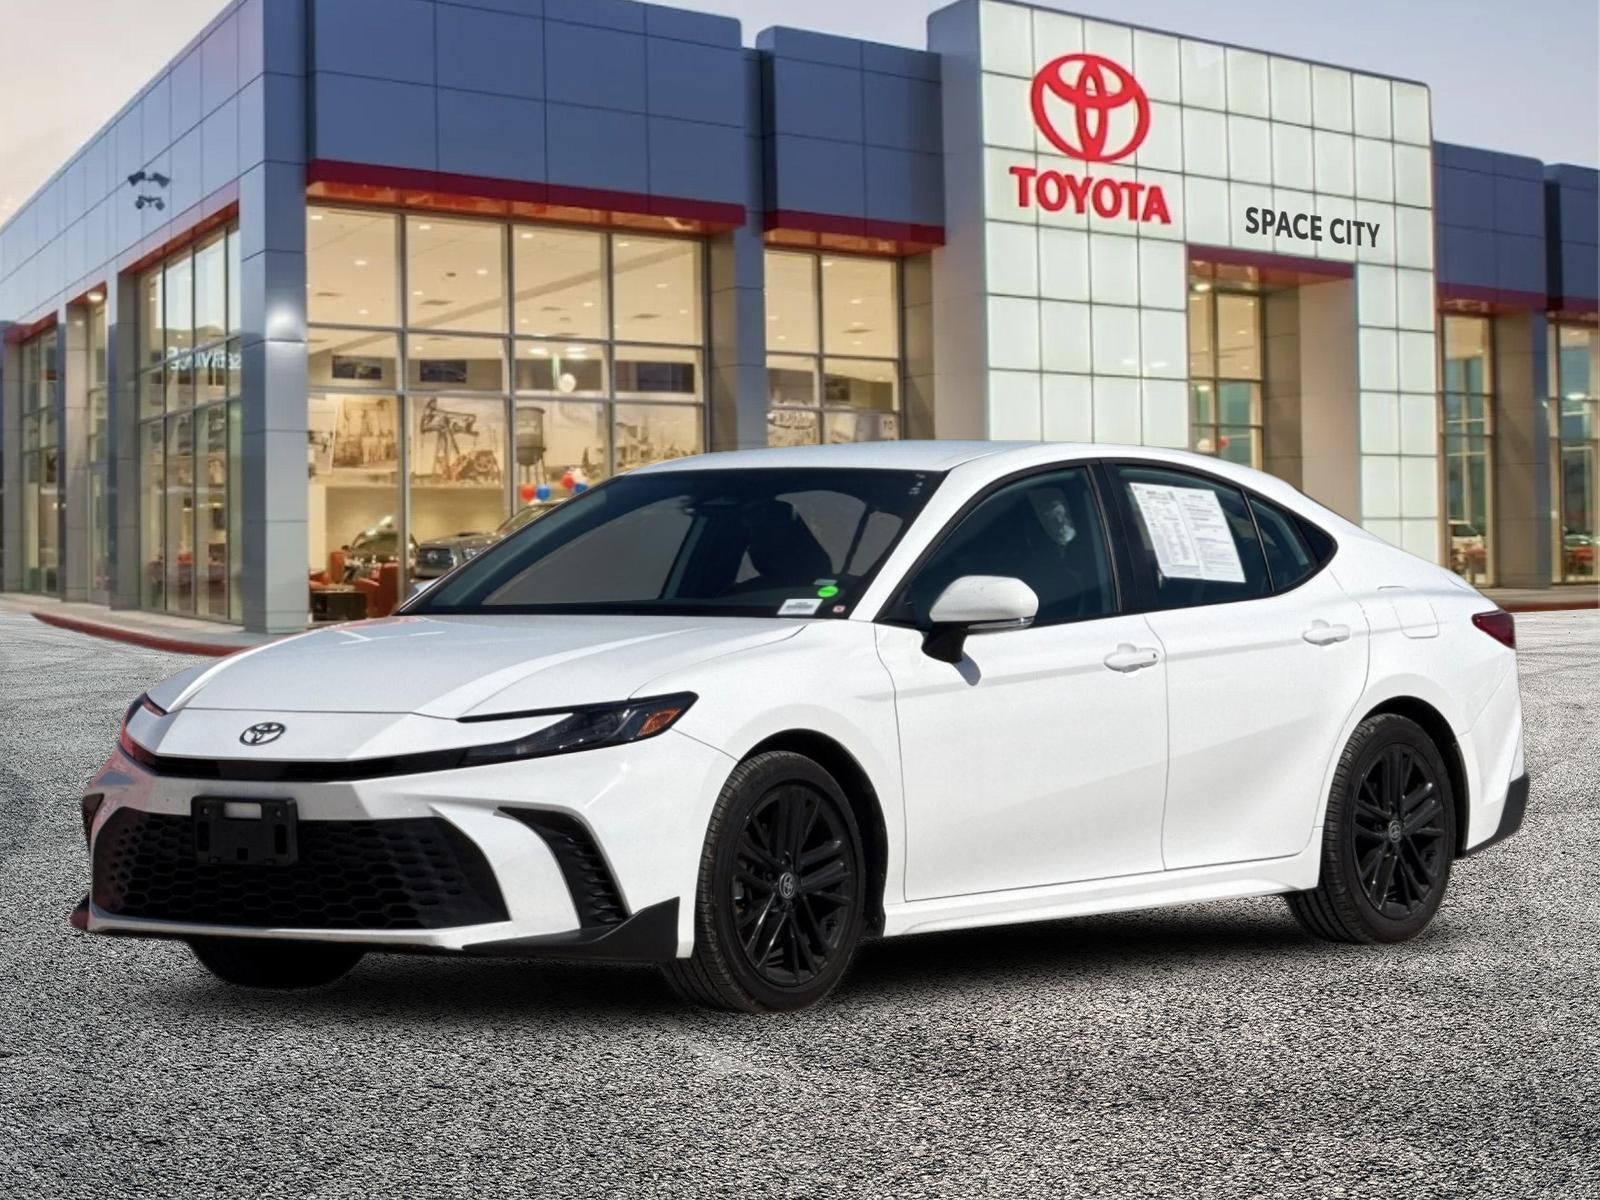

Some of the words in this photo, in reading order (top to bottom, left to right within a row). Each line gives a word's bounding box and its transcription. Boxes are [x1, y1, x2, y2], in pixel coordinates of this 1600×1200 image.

[1009, 166, 1171, 224] TOYOTA
[1245, 206, 1322, 242] SPACE
[1329, 218, 1380, 247] CITY
